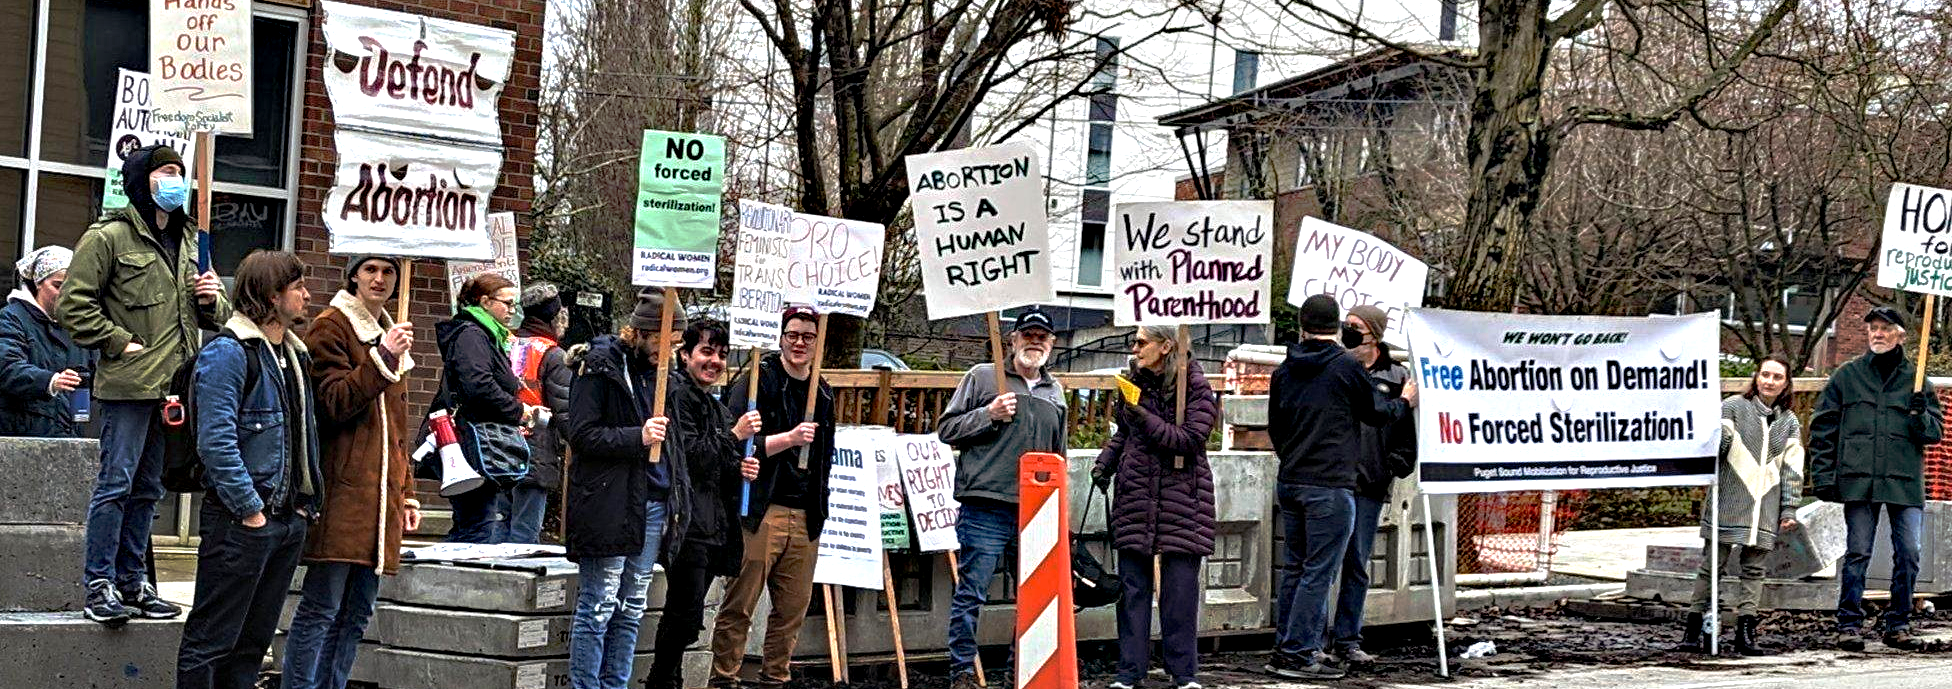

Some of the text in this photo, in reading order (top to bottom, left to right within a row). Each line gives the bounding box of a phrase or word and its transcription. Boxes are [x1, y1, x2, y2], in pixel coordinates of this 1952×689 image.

[186, 13, 219, 31] off
[158, 54, 243, 82] Bodies
[357, 35, 482, 110] Defend
[665, 136, 705, 161] NO
[654, 163, 713, 182] forced
[915, 155, 1030, 193] ABORTION
[339, 162, 478, 232] Abortion
[642, 198, 717, 213] sterilization!
[932, 198, 999, 224] IS A
[1900, 185, 1952, 235] HO
[787, 216, 850, 260] PRO
[935, 221, 1025, 257] HUMAN
[1122, 212, 1266, 252] We stand
[640, 251, 711, 263] RADICAL WOMEN
[641, 264, 710, 277] radicalwomen.org
[787, 245, 880, 289] CHOICE!
[945, 249, 1040, 287] RIGHT
[1119, 248, 1265, 285] with Planned
[1303, 229, 1405, 282] MY BODY
[737, 263, 784, 290] TRANS
[1328, 265, 1365, 288] MY
[1896, 265, 1952, 292] justic
[1123, 282, 1262, 322] Parenthood
[1502, 331, 1630, 346] WE WON'T GO BACK!
[1419, 356, 1709, 392] Free Abortion on Demand!
[1437, 410, 1695, 445] No Forced Sterilization!
[906, 440, 941, 462] OUR
[905, 462, 951, 495] RIGHT
[1473, 463, 1658, 480] Puget Sound Mobilization for Reproductive Justice
[926, 492, 945, 509] TO
